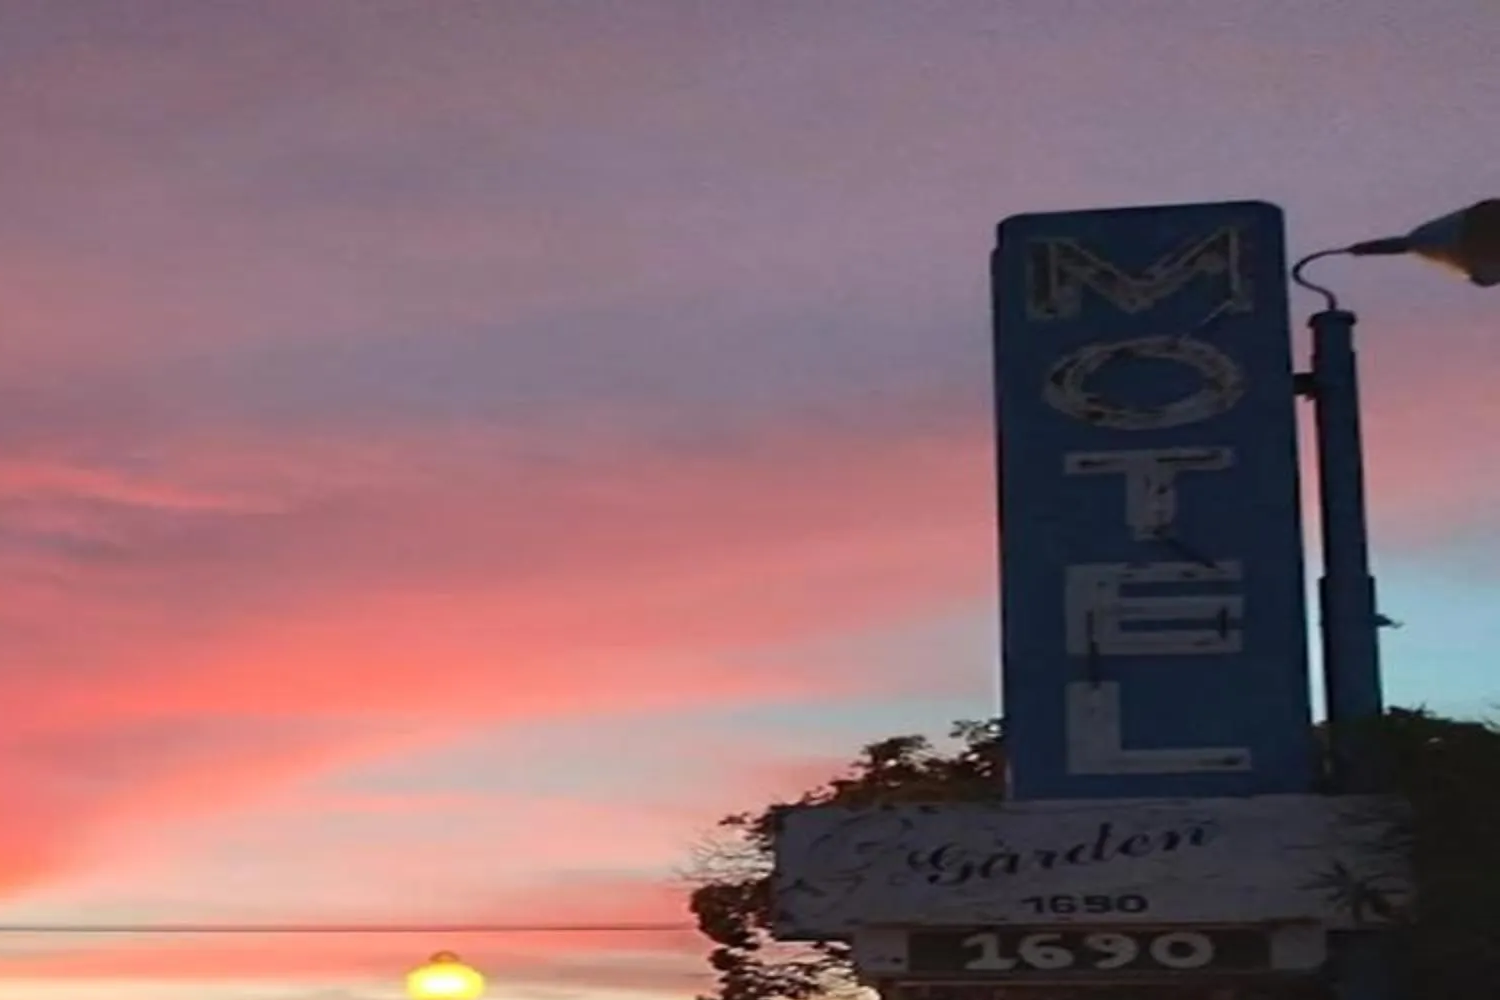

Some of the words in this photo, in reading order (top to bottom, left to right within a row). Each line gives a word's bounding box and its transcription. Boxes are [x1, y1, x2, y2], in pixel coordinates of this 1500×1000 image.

[1025, 224, 1254, 776] MOTEL
[906, 820, 1214, 887] Garden
[960, 930, 1216, 970] 1690
